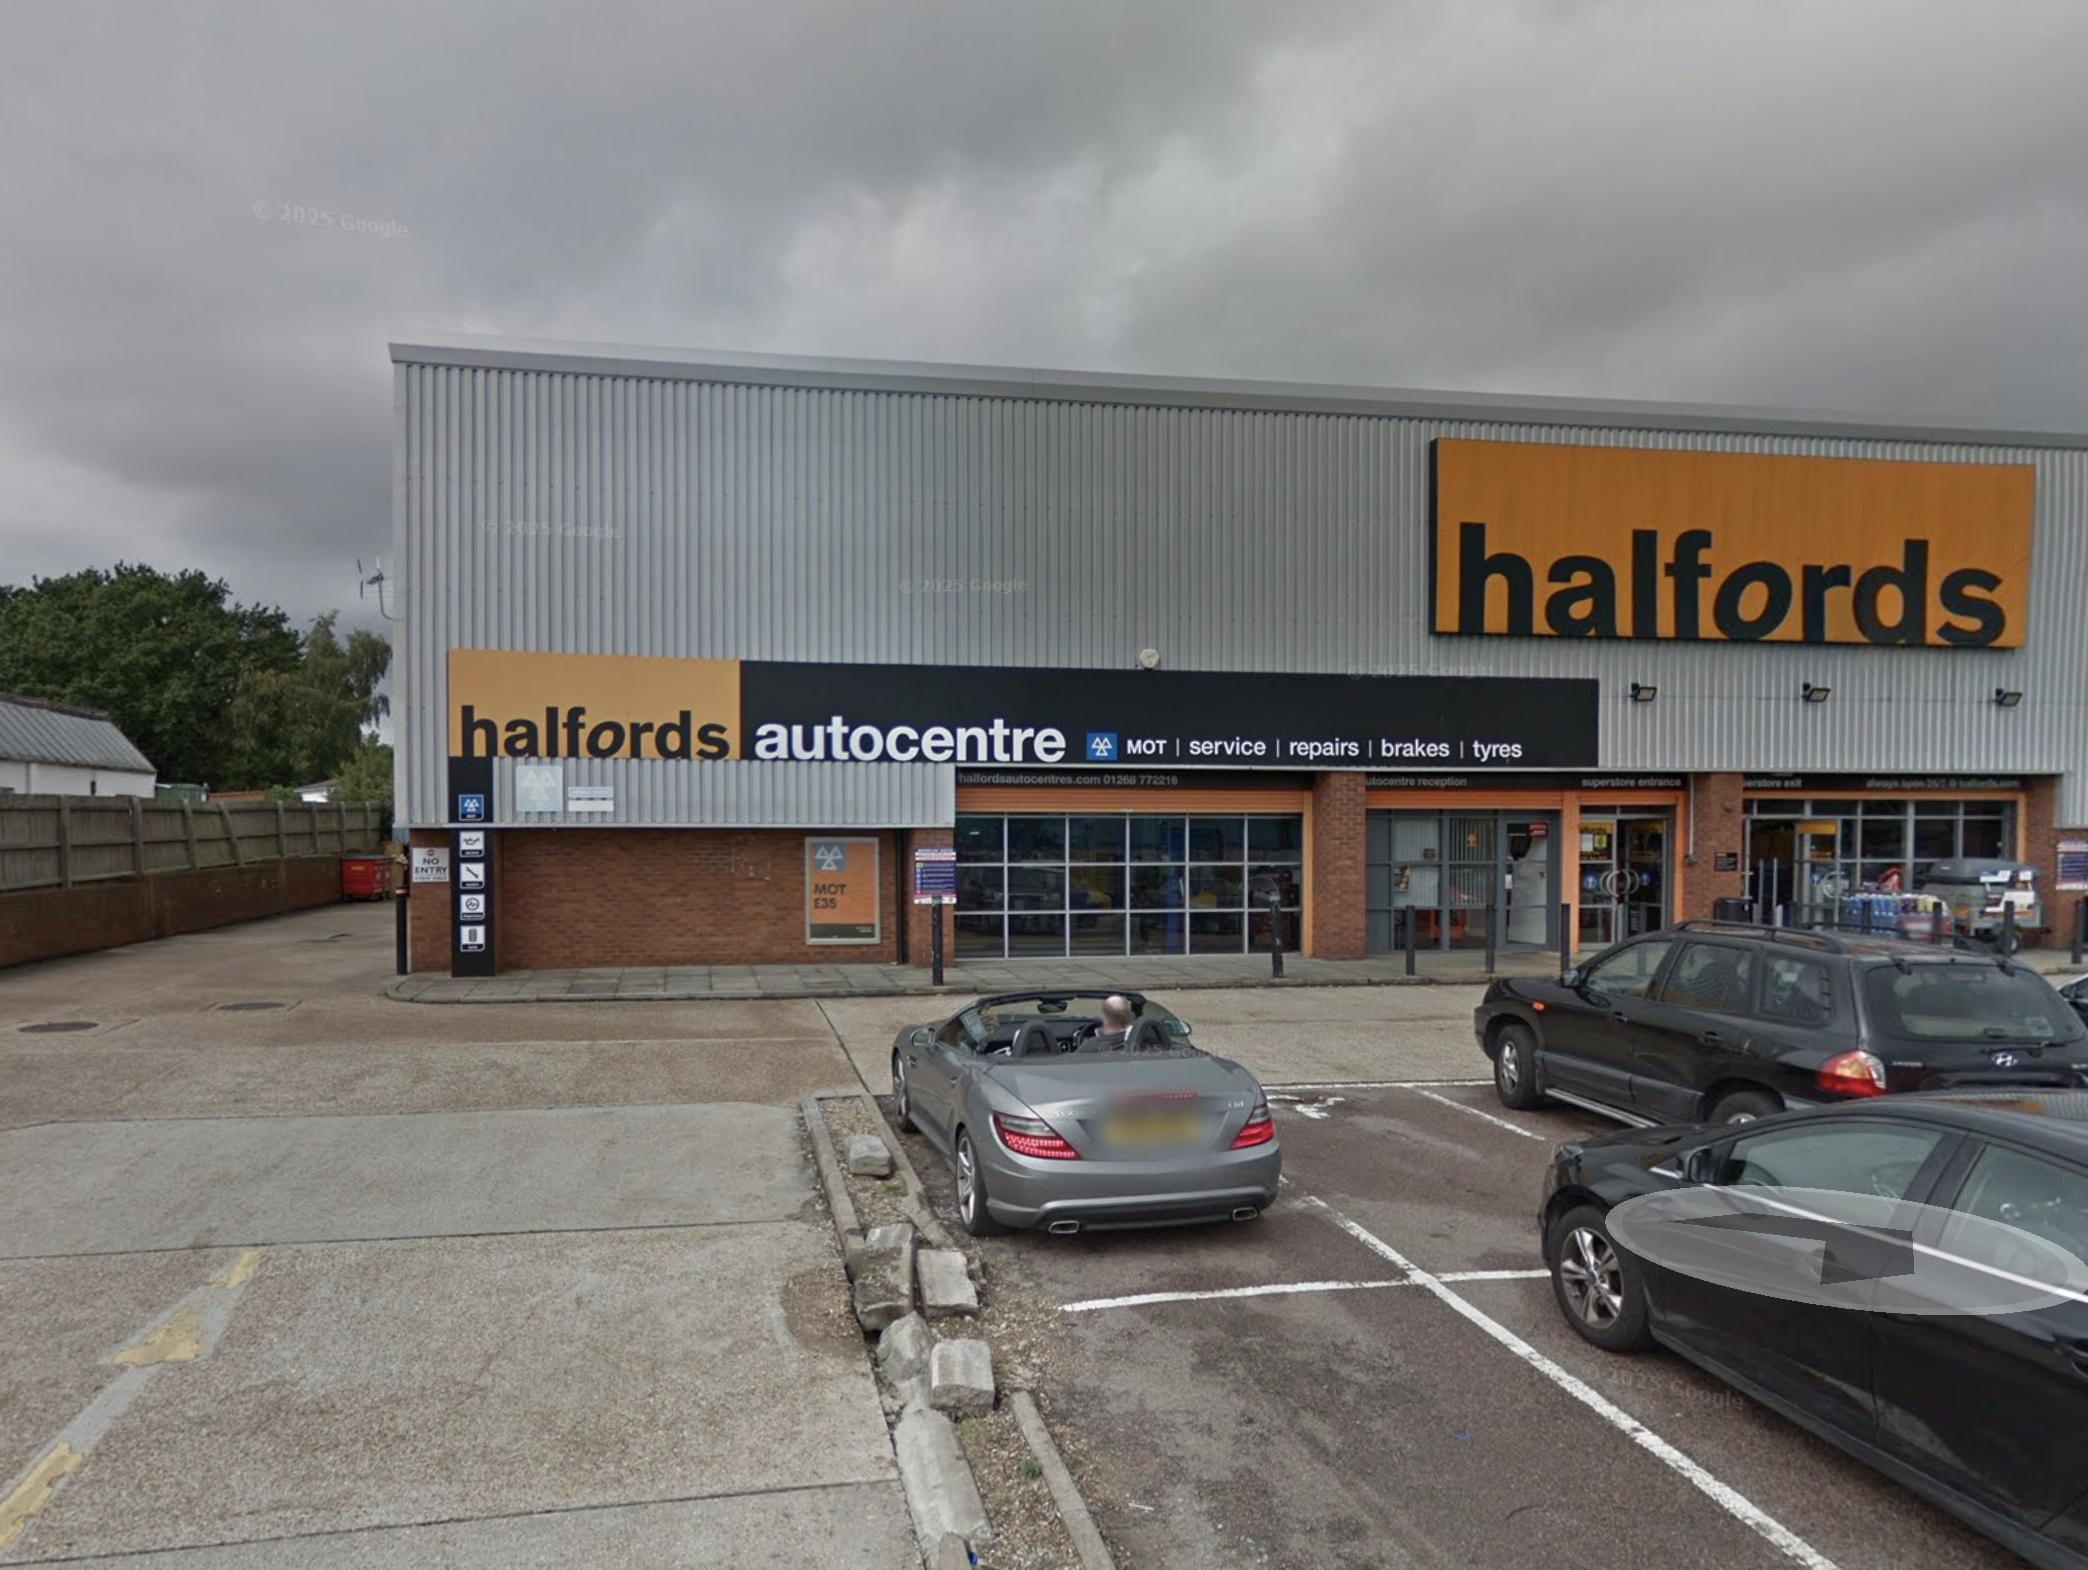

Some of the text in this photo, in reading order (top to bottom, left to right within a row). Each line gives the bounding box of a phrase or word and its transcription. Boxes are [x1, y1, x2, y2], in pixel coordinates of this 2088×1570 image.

[1458, 521, 2006, 646] halfords
[461, 704, 1067, 763] halfords autocentre
[1126, 736, 1523, 763] MOT service repairs brakes tyres
[1103, 774, 1137, 785] 01268
[1365, 776, 1468, 789] utocentre reception
[1581, 777, 1682, 789] superstore entrance
[422, 857, 439, 865] NO
[415, 866, 447, 874] ENTRY
[813, 883, 847, 895] MOT
